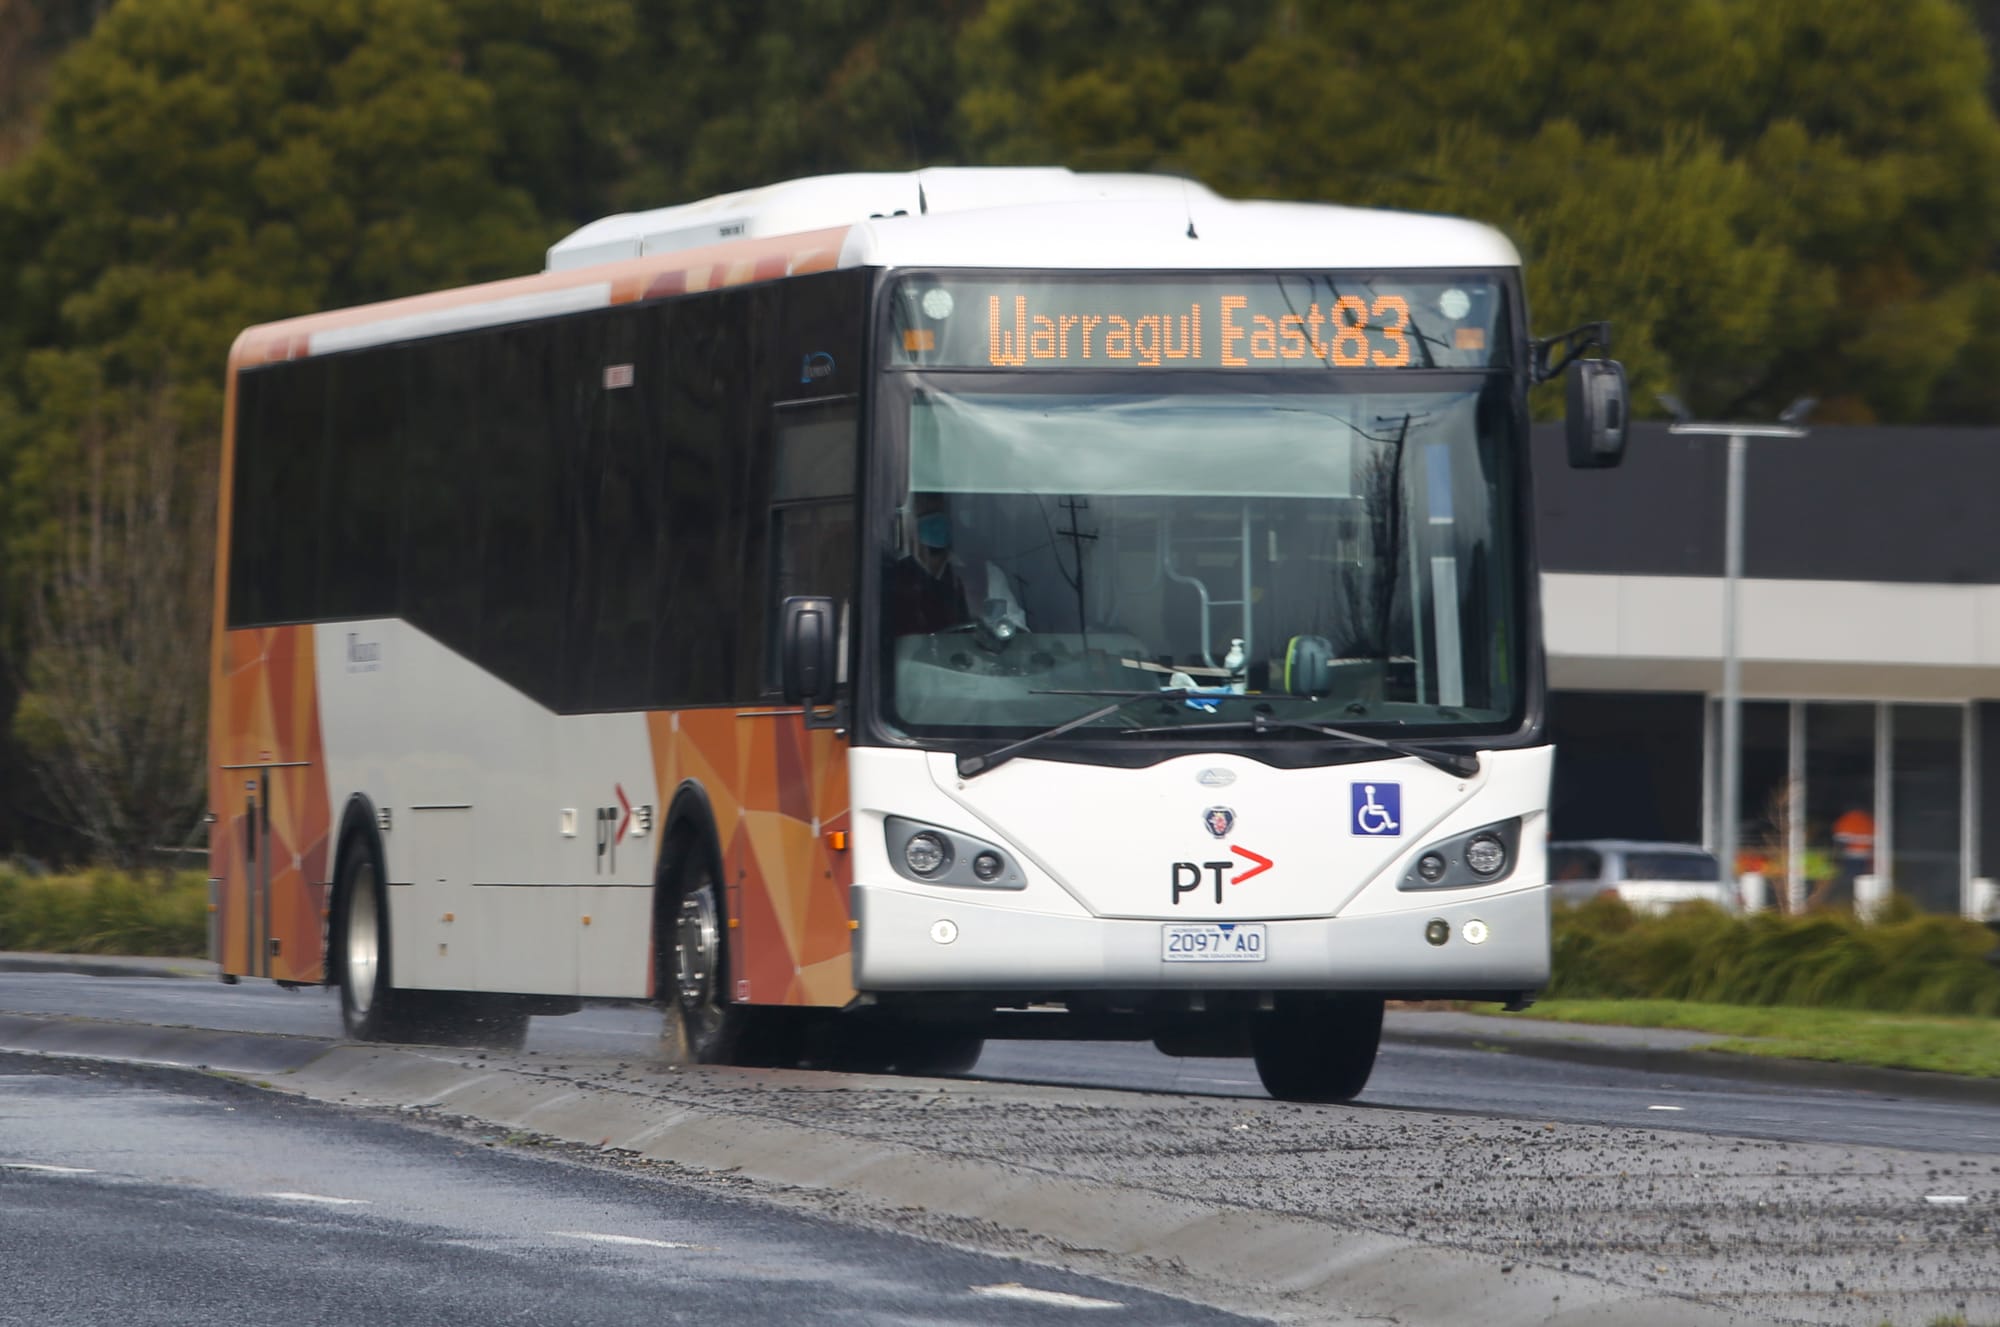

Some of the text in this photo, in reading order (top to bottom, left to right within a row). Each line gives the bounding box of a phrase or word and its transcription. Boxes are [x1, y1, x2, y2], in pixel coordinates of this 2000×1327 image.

[988, 294, 1410, 367] Warragul East 83
[1172, 862, 1233, 905] PT
[1169, 933, 1220, 952] 2097
